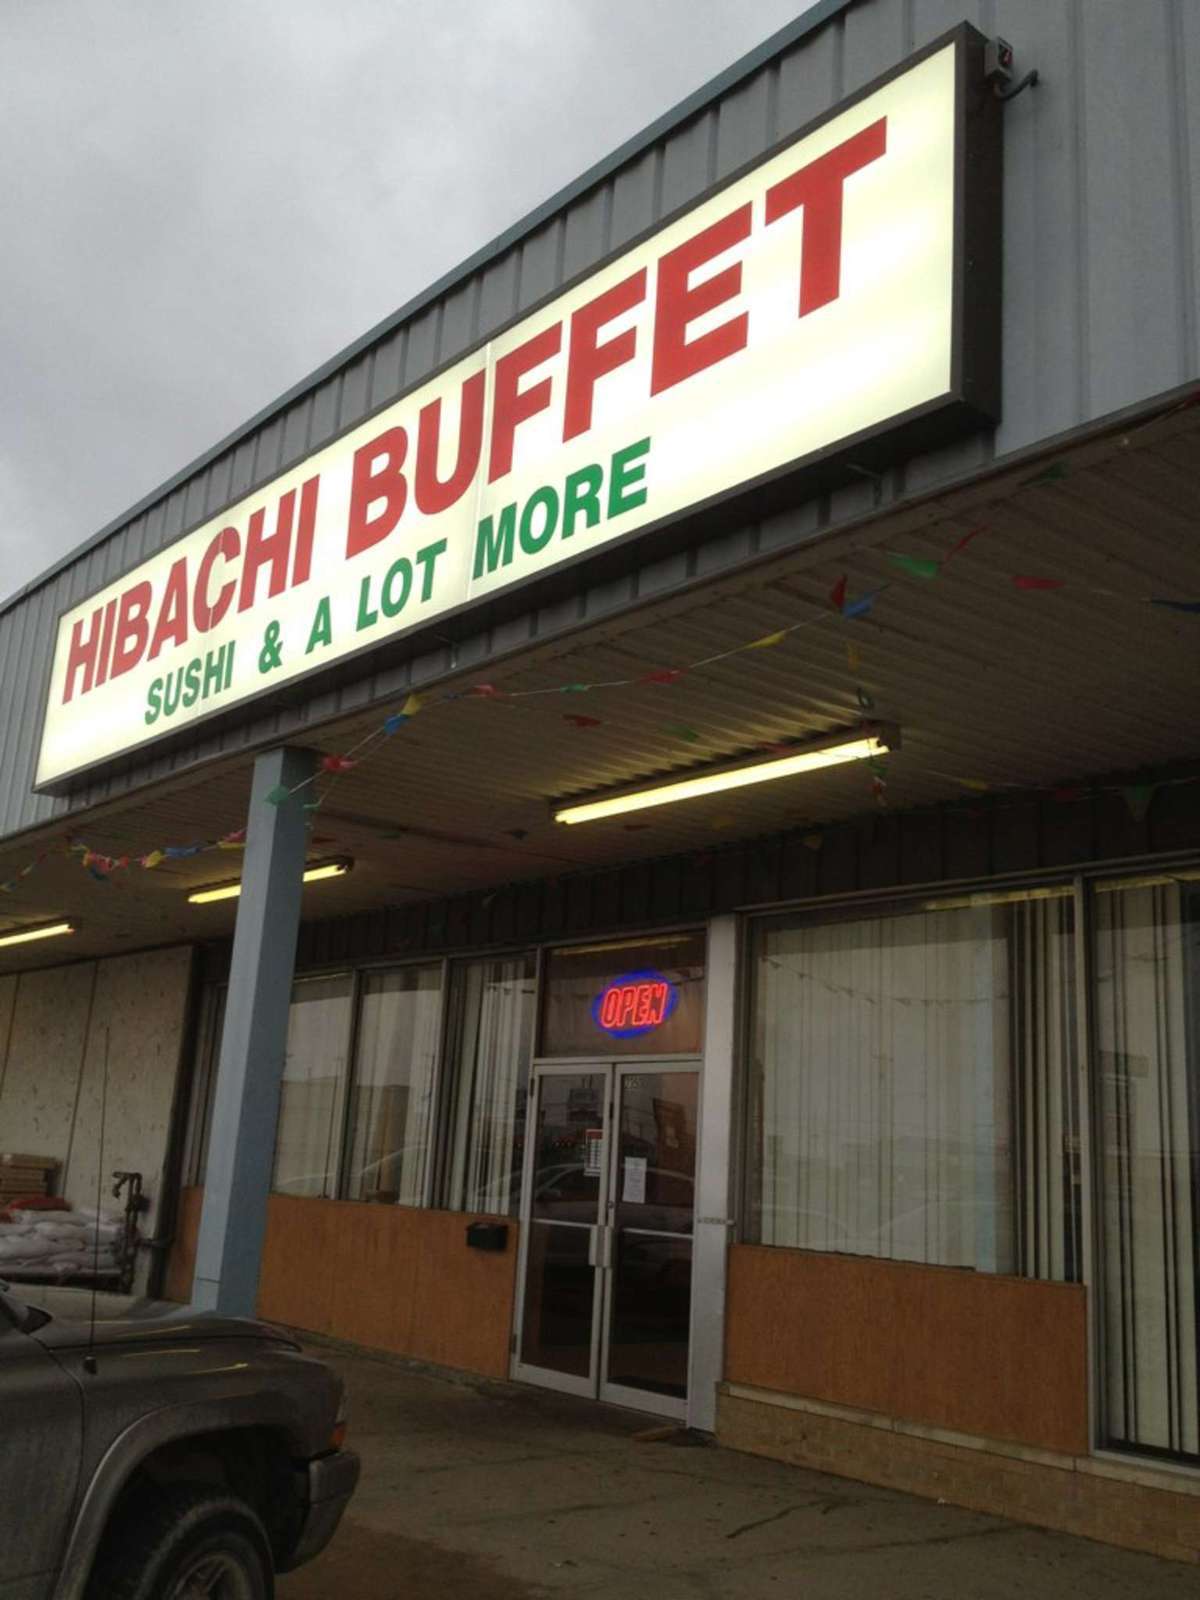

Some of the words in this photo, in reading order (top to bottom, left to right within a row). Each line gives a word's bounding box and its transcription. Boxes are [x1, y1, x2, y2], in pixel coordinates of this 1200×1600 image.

[63, 475, 320, 704] HIBACHI
[346, 117, 887, 559] BUFFET
[144, 641, 235, 725] SUSHI
[258, 621, 283, 674] &
[305, 597, 332, 654] A
[356, 539, 447, 631] LOT
[473, 437, 650, 579] MORE
[600, 982, 668, 1028] OPEN
